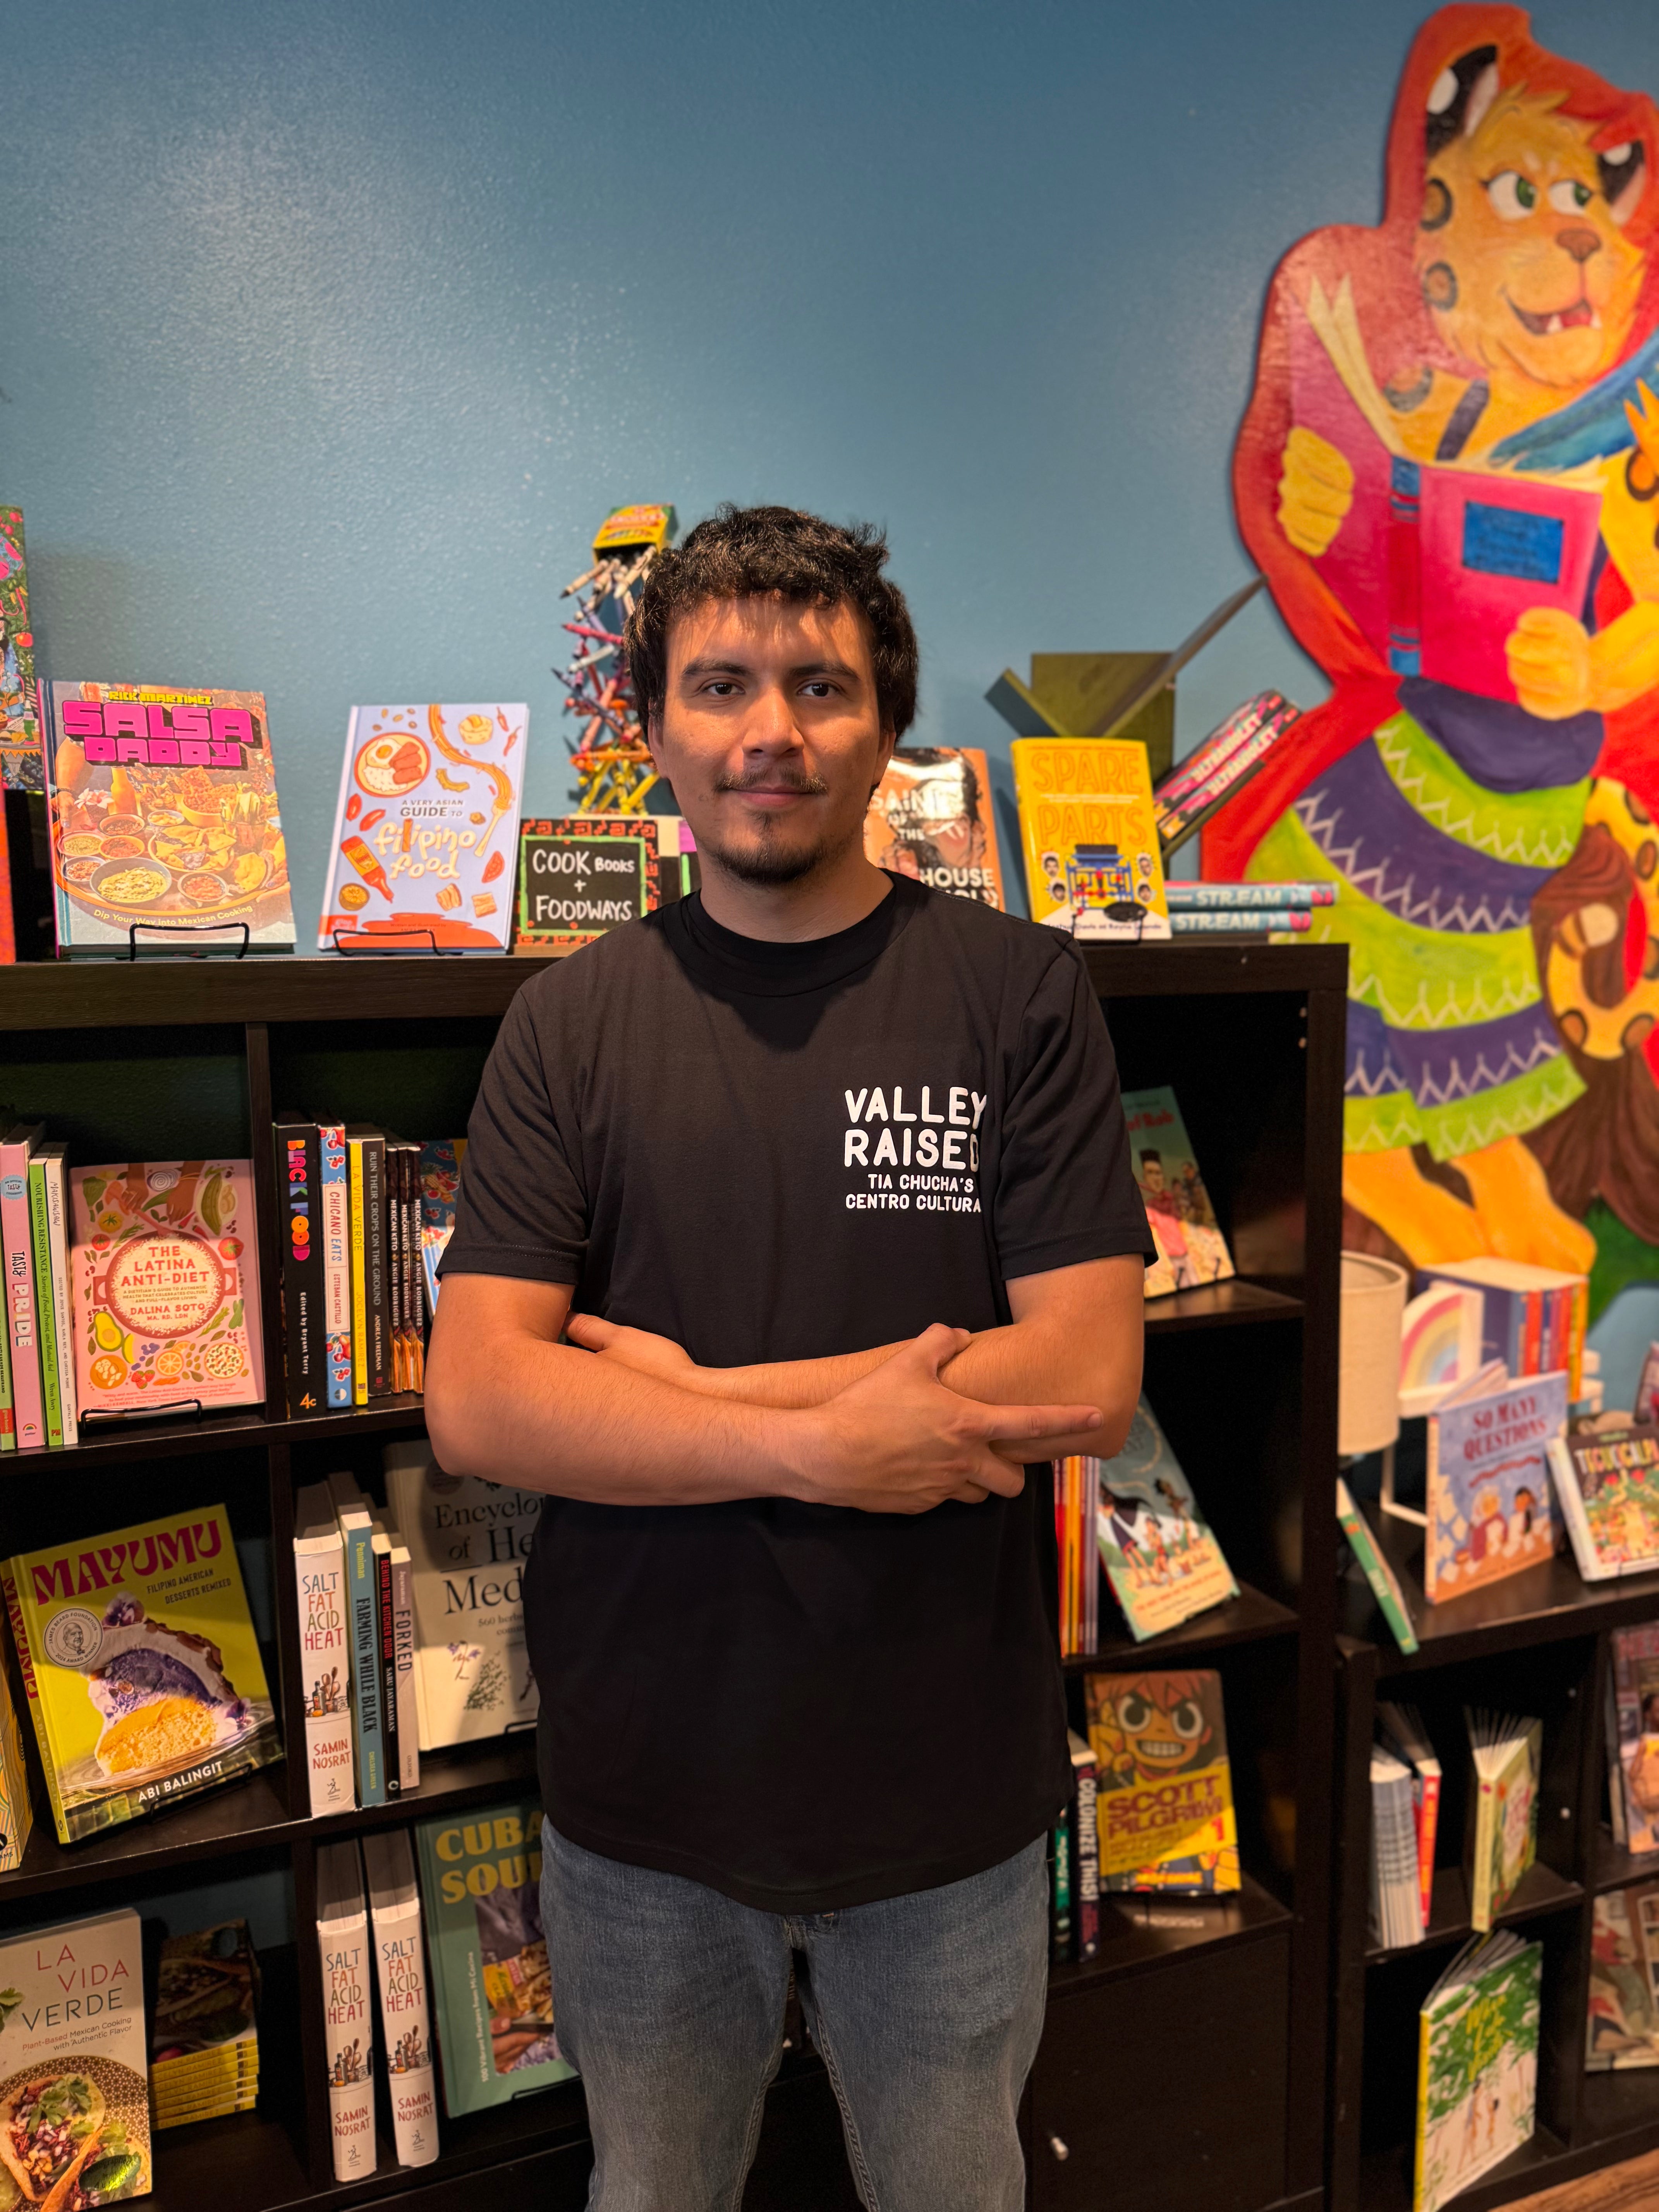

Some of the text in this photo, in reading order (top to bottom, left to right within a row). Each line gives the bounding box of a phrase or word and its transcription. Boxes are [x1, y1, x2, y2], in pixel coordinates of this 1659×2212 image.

[108, 691, 138, 701] RICK
[63, 701, 254, 742] SALSA
[84, 737, 242, 766] DADDY
[1031, 752, 1144, 793] SPARE
[400, 807, 447, 816] GUIDE
[898, 828, 925, 841] THE
[1037, 804, 1147, 846] PARTS
[373, 818, 476, 860] filipino
[389, 849, 460, 879] food
[532, 848, 592, 875] COOK
[919, 867, 995, 887] HOUSE
[94, 905, 253, 926] Dip Your Way into Mexican Cooking
[536, 895, 633, 922] FOODWAYS
[845, 1086, 987, 1130] VALLEY
[868, 1174, 974, 1193] TIA CHUCHA'S
[50, 1182, 61, 1226] MAKISAWSAW
[288, 1140, 310, 1261] BLACK FOOD
[352, 1166, 362, 1251] LA VIDA VERDE
[846, 1194, 981, 1213] CENTRO CULTURA
[35, 1182, 48, 1273] NOURISHING RESISTANCE
[330, 1191, 342, 1262] CHICANO EATS
[369, 1152, 381, 1306] RUIN THEIR CROPS ON THE GROUND
[148, 1245, 181, 1257] THE
[134, 1258, 196, 1272] LATINA
[121, 1271, 210, 1286] ANTI-DIET
[12, 1250, 33, 1347] TASTY PRIDE
[130, 1303, 205, 1315] DALINA SOTO
[300, 1317, 307, 1326] by
[1464, 1417, 1546, 1462] QUESTIONS
[356, 1542, 366, 1579] Penniman
[448, 1535, 471, 1561] of
[31, 1519, 222, 1606] MAYUMU
[146, 1568, 215, 1594] FILIPINO AMERICAN
[165, 1577, 232, 1604] DESSERTS REMIXED
[302, 1572, 339, 1594] SALT
[308, 1591, 336, 1613] FAT
[381, 1559, 393, 1659] BEHIND THE KITCHEN DOOR
[54, 1614, 69, 1627] BEARD
[70, 1612, 98, 1631] FOUNDATION
[307, 1610, 340, 1632] ACID
[356, 1597, 373, 1651] FARMING
[305, 1627, 344, 1650] HEAT
[396, 1609, 413, 1671] FORKED
[55, 1653, 66, 1662] 2024
[84, 1642, 98, 1658] WINNER
[359, 1653, 375, 1693] WHILE
[362, 1693, 378, 1733] BLACK
[386, 1687, 395, 1733] JAYARAMAN
[313, 1738, 349, 1756] SAMIN
[313, 1750, 351, 1770] NOSRAT
[139, 1761, 222, 1803] ABI BALINGIT
[1107, 1775, 1220, 1820] SCOTT
[1078, 1778, 1097, 1855] COLONIZE
[1108, 1795, 1223, 1839] PILGRIM
[1211, 1816, 1224, 1841] 1
[37, 1944, 76, 1971] LA
[326, 1948, 361, 1972] SALT
[382, 1936, 416, 1961] SALT
[57, 1959, 129, 1993] VIDA
[332, 1966, 358, 1989] FAT
[388, 1954, 414, 1977] FAT
[331, 1984, 361, 2007] ACID
[388, 1972, 419, 1996] ACID
[21, 1987, 123, 2032] VERDE
[328, 1999, 365, 2025] HEAT
[386, 1987, 423, 2013] HEAT
[22, 2017, 132, 2051] Plant-Based Mexican Cooking
[53, 2025, 132, 2051] with Authentic Flavor
[397, 2102, 434, 2122] NOSRAT
[398, 2091, 431, 2109] SAMIN
[334, 2117, 371, 2136] NOSRAT
[335, 2105, 368, 2124] SAMIN
